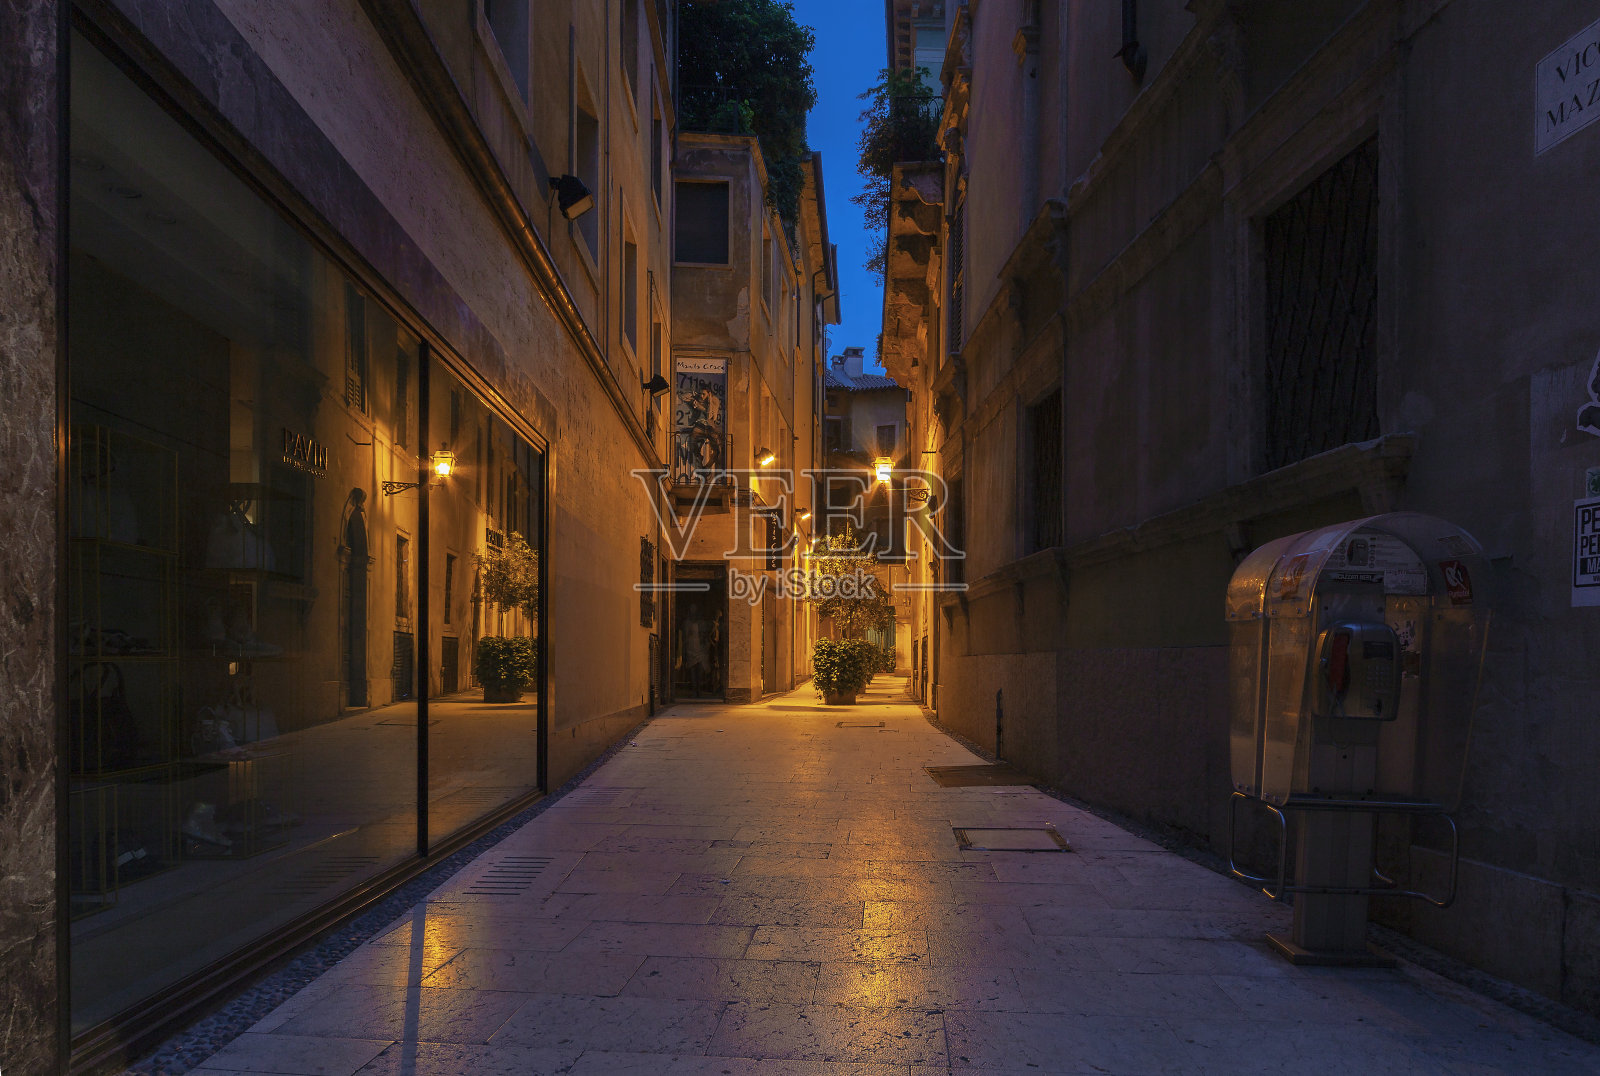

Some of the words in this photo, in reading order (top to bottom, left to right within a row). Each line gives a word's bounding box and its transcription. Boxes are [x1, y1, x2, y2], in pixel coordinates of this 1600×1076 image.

[1556, 41, 1600, 83] VIC
[283, 428, 329, 471] PAVIN
[1581, 534, 1600, 556] PE
